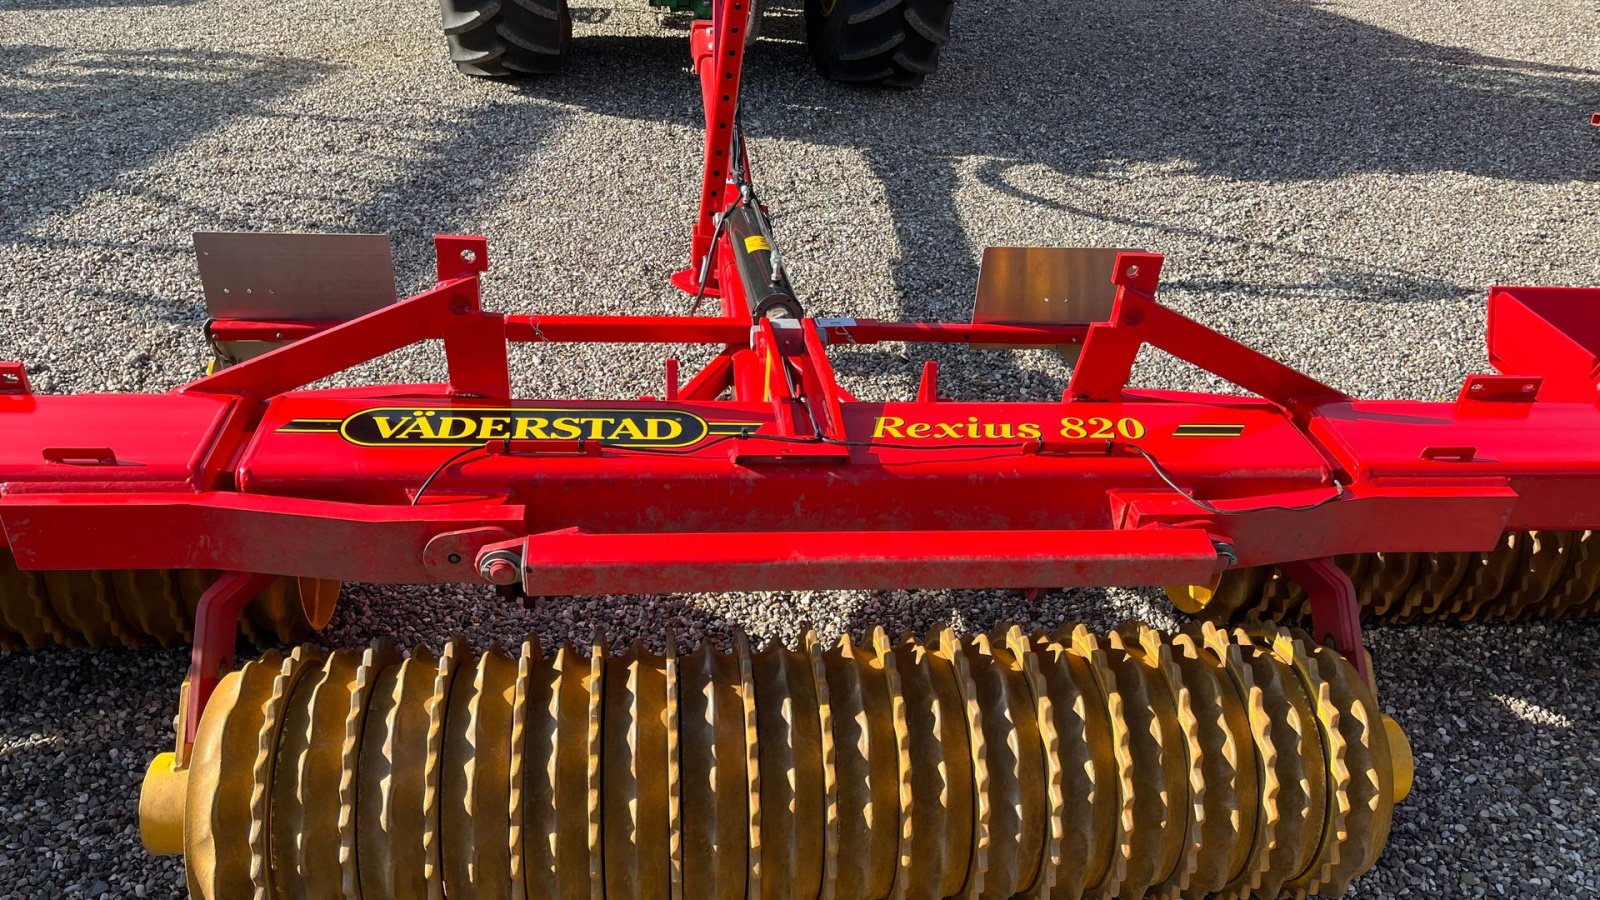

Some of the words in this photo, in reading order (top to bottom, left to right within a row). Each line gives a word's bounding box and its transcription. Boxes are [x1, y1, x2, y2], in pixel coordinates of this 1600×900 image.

[372, 411, 682, 440] VÄDERSTAD
[871, 416, 1042, 440] Rexius
[1060, 417, 1145, 440] 820
